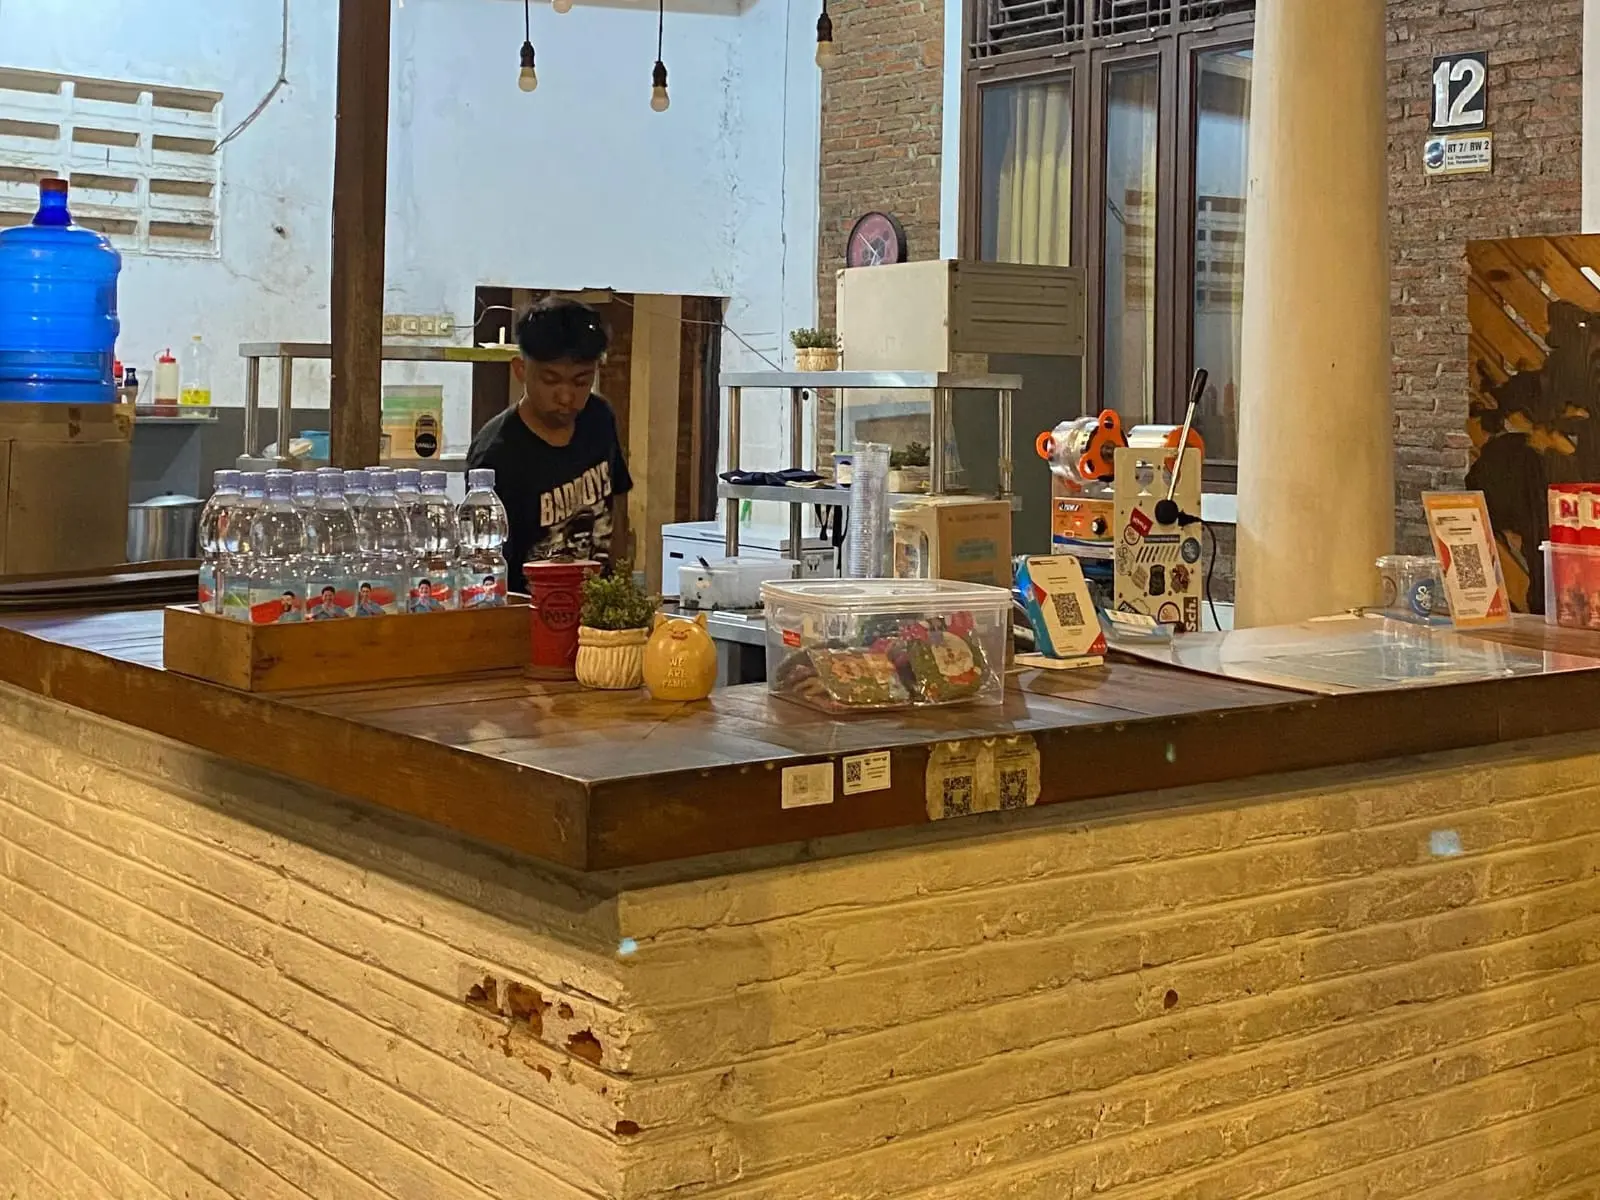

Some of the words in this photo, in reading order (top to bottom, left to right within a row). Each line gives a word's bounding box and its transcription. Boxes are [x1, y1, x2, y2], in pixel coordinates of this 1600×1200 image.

[1433, 58, 1485, 127] 12
[1447, 143, 1457, 153] RT
[1470, 141, 1482, 151] RW
[1484, 140, 1490, 150] 2
[545, 611, 574, 623] POST
[1185, 598, 1197, 632] Sch.
